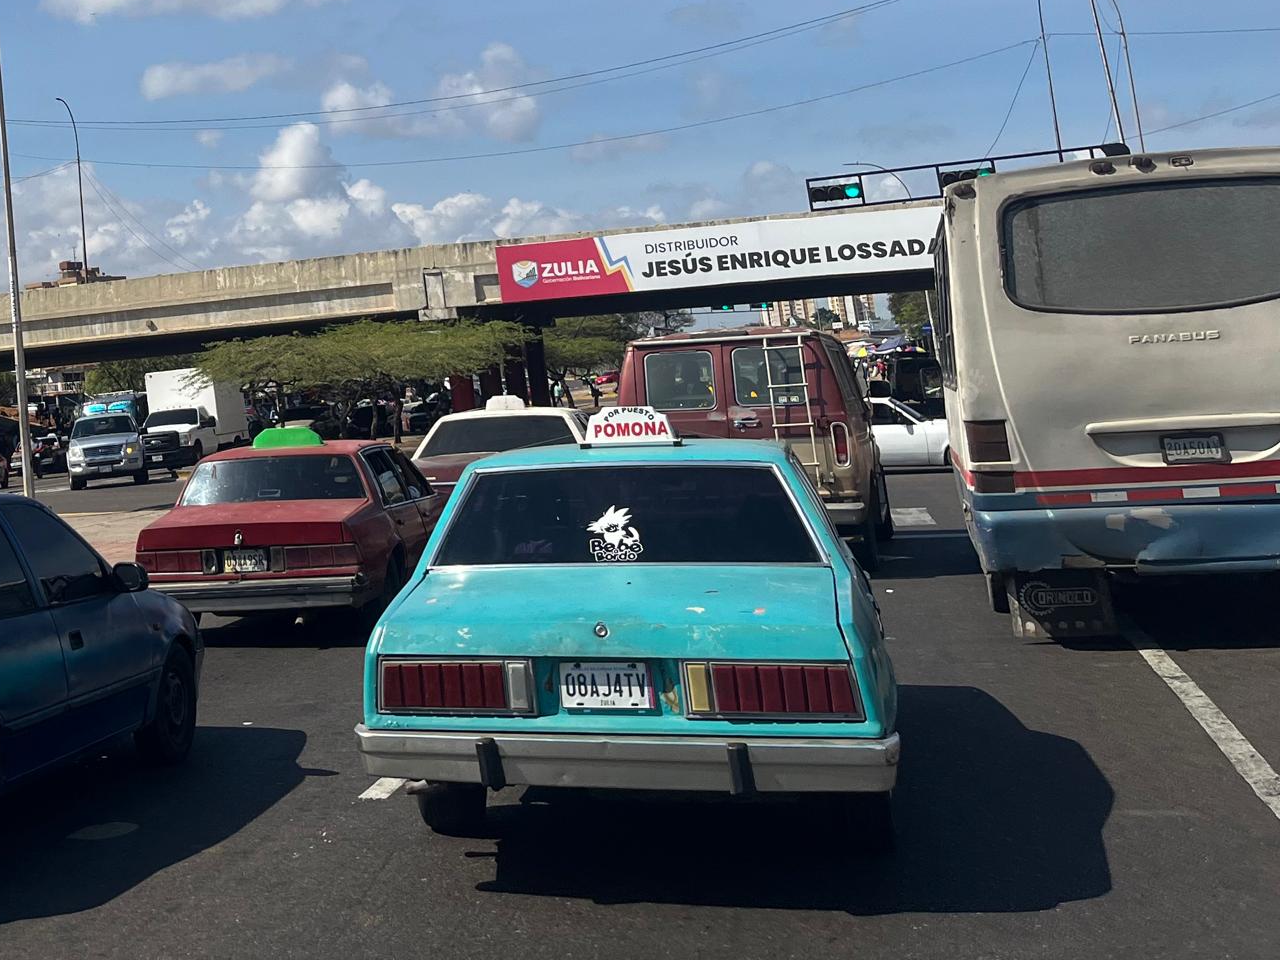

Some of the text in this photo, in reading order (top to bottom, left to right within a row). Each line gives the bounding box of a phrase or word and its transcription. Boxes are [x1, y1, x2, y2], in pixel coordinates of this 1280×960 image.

[645, 235, 739, 254] DISTRIBUIDOR
[541, 259, 600, 278] ZULIA
[642, 252, 714, 278] JESÚS
[716, 246, 822, 271] ENRIQUE
[604, 407, 655, 422] POR PUESTO
[594, 421, 668, 438] POMONA
[595, 550, 638, 561] Bordo
[565, 672, 646, 698] 08AJ4TV
